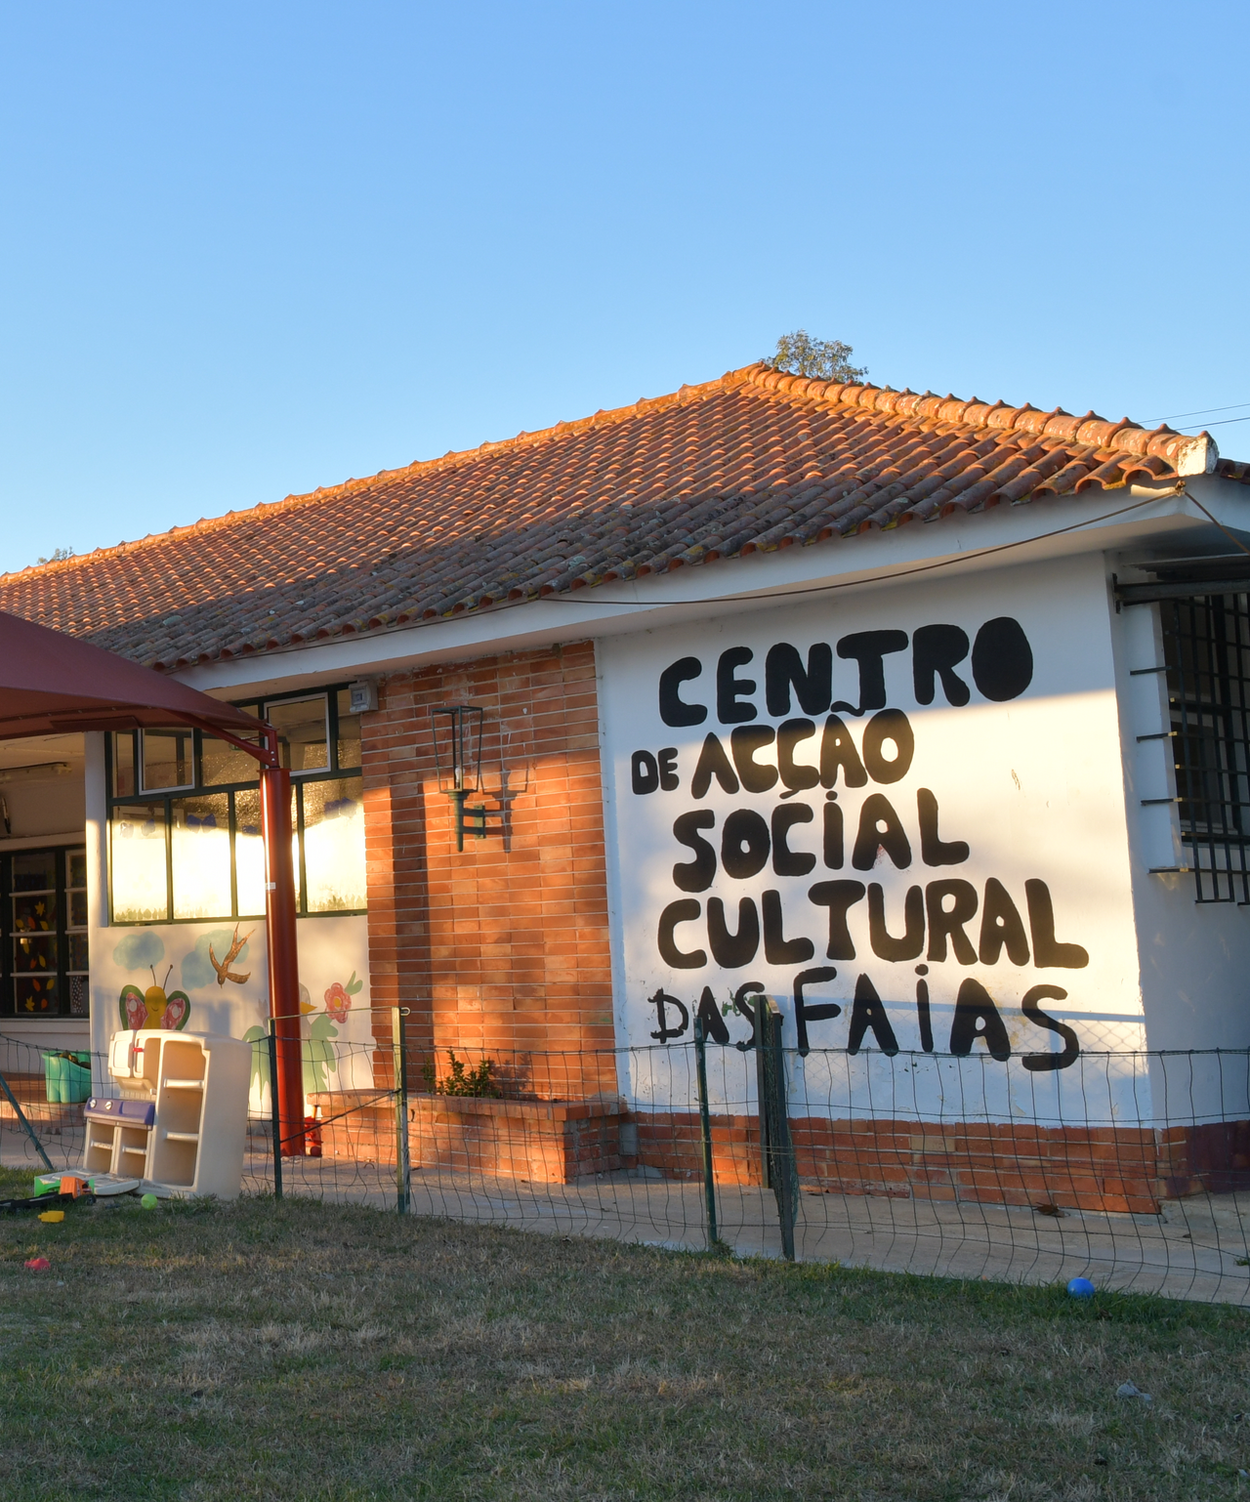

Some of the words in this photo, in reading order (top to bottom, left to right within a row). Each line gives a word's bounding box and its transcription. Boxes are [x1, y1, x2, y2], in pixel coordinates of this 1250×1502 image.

[659, 616, 1034, 728] CENTRO
[631, 747, 680, 795] DE
[657, 877, 1090, 969] CULTURAL
[647, 981, 766, 1052] DAS
